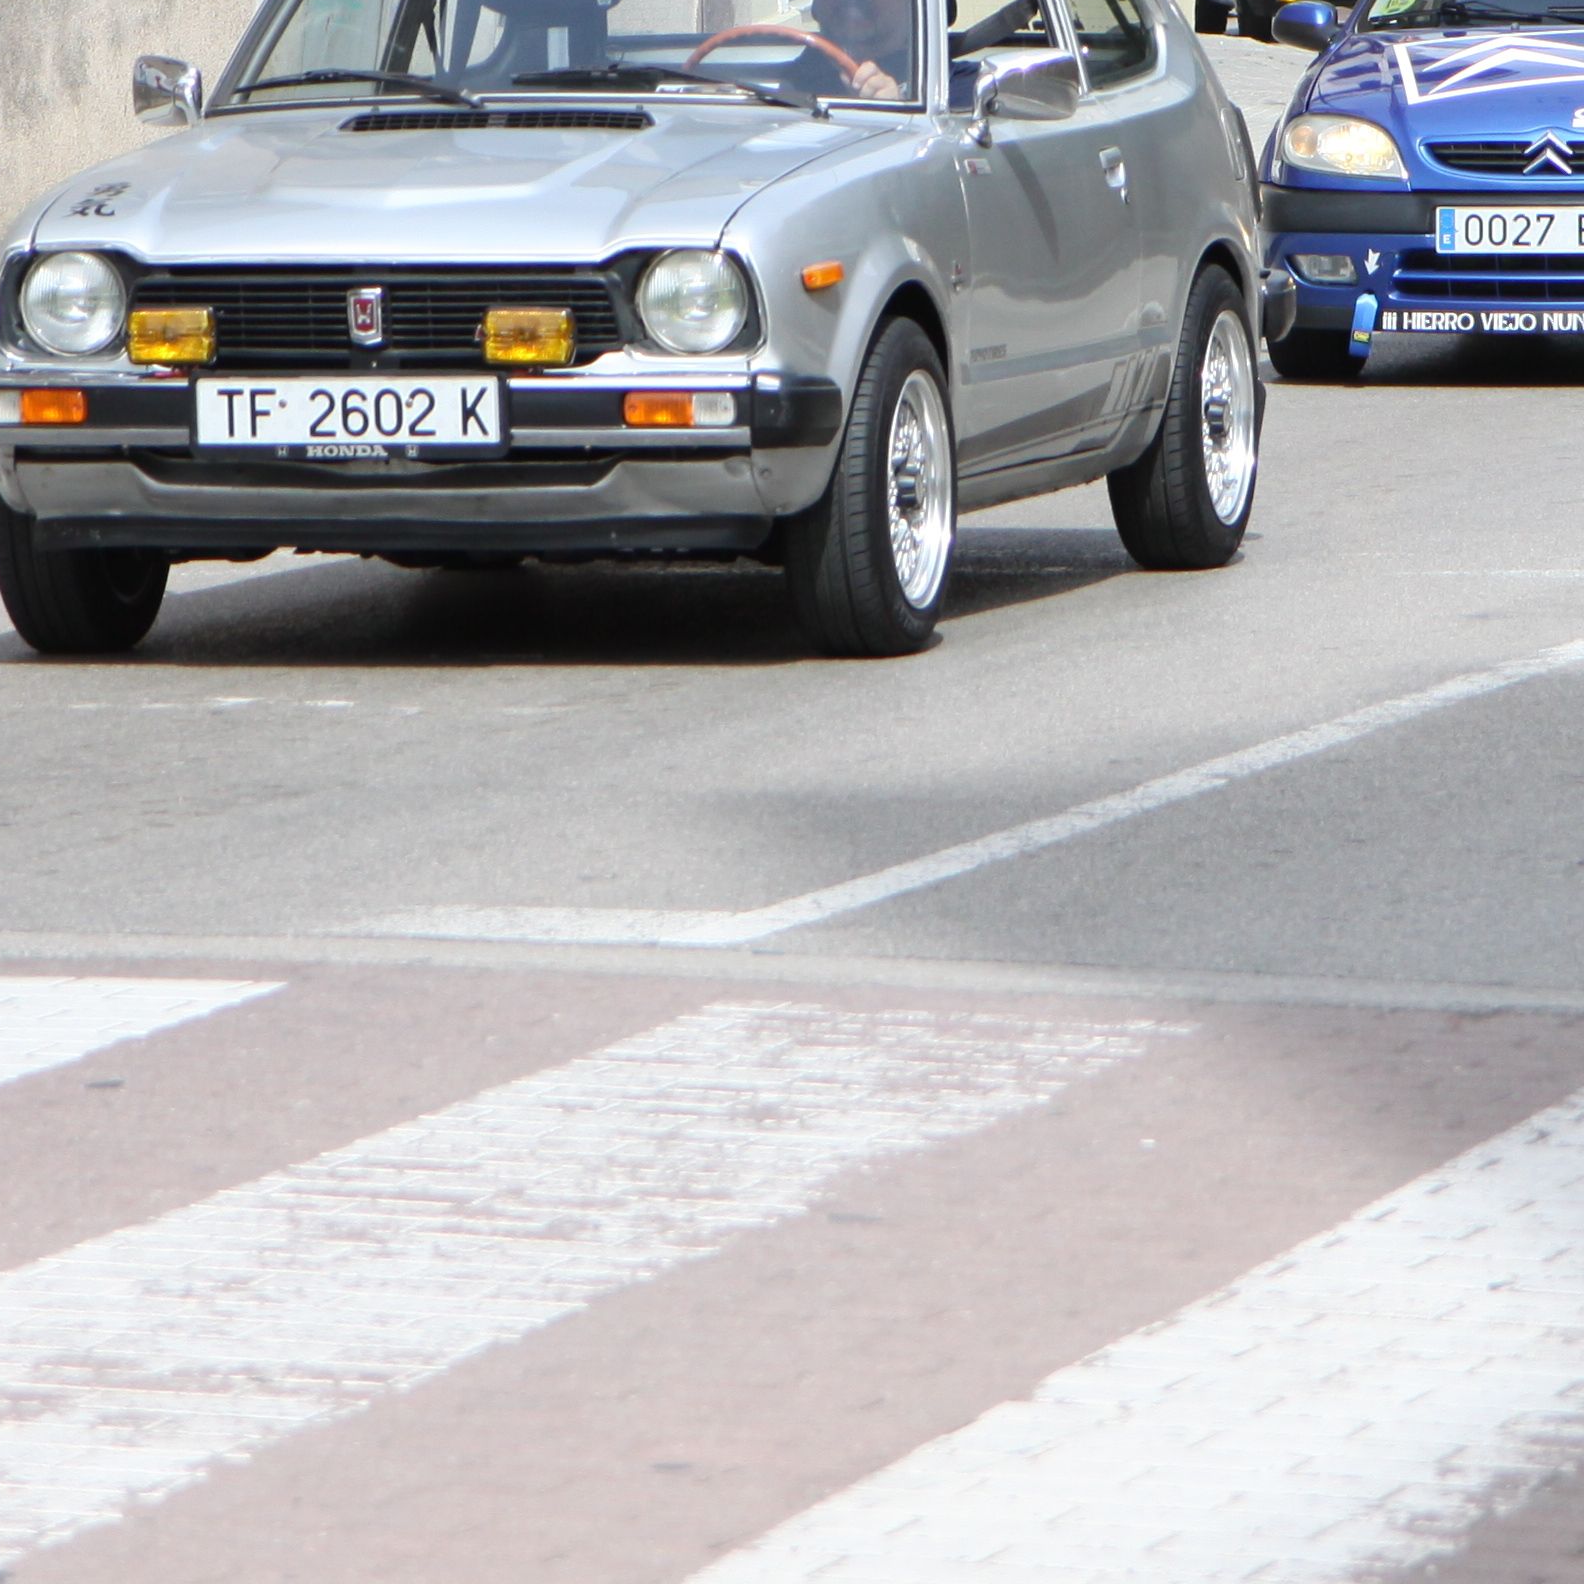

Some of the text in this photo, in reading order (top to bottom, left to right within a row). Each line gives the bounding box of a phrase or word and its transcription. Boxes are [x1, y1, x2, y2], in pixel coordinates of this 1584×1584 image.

[1465, 214, 1555, 246] 0027
[1403, 312, 1475, 331] HIERRO
[1480, 312, 1537, 331] VIEJO
[217, 387, 489, 438] TF 2602 K
[306, 444, 388, 458] HONDA
